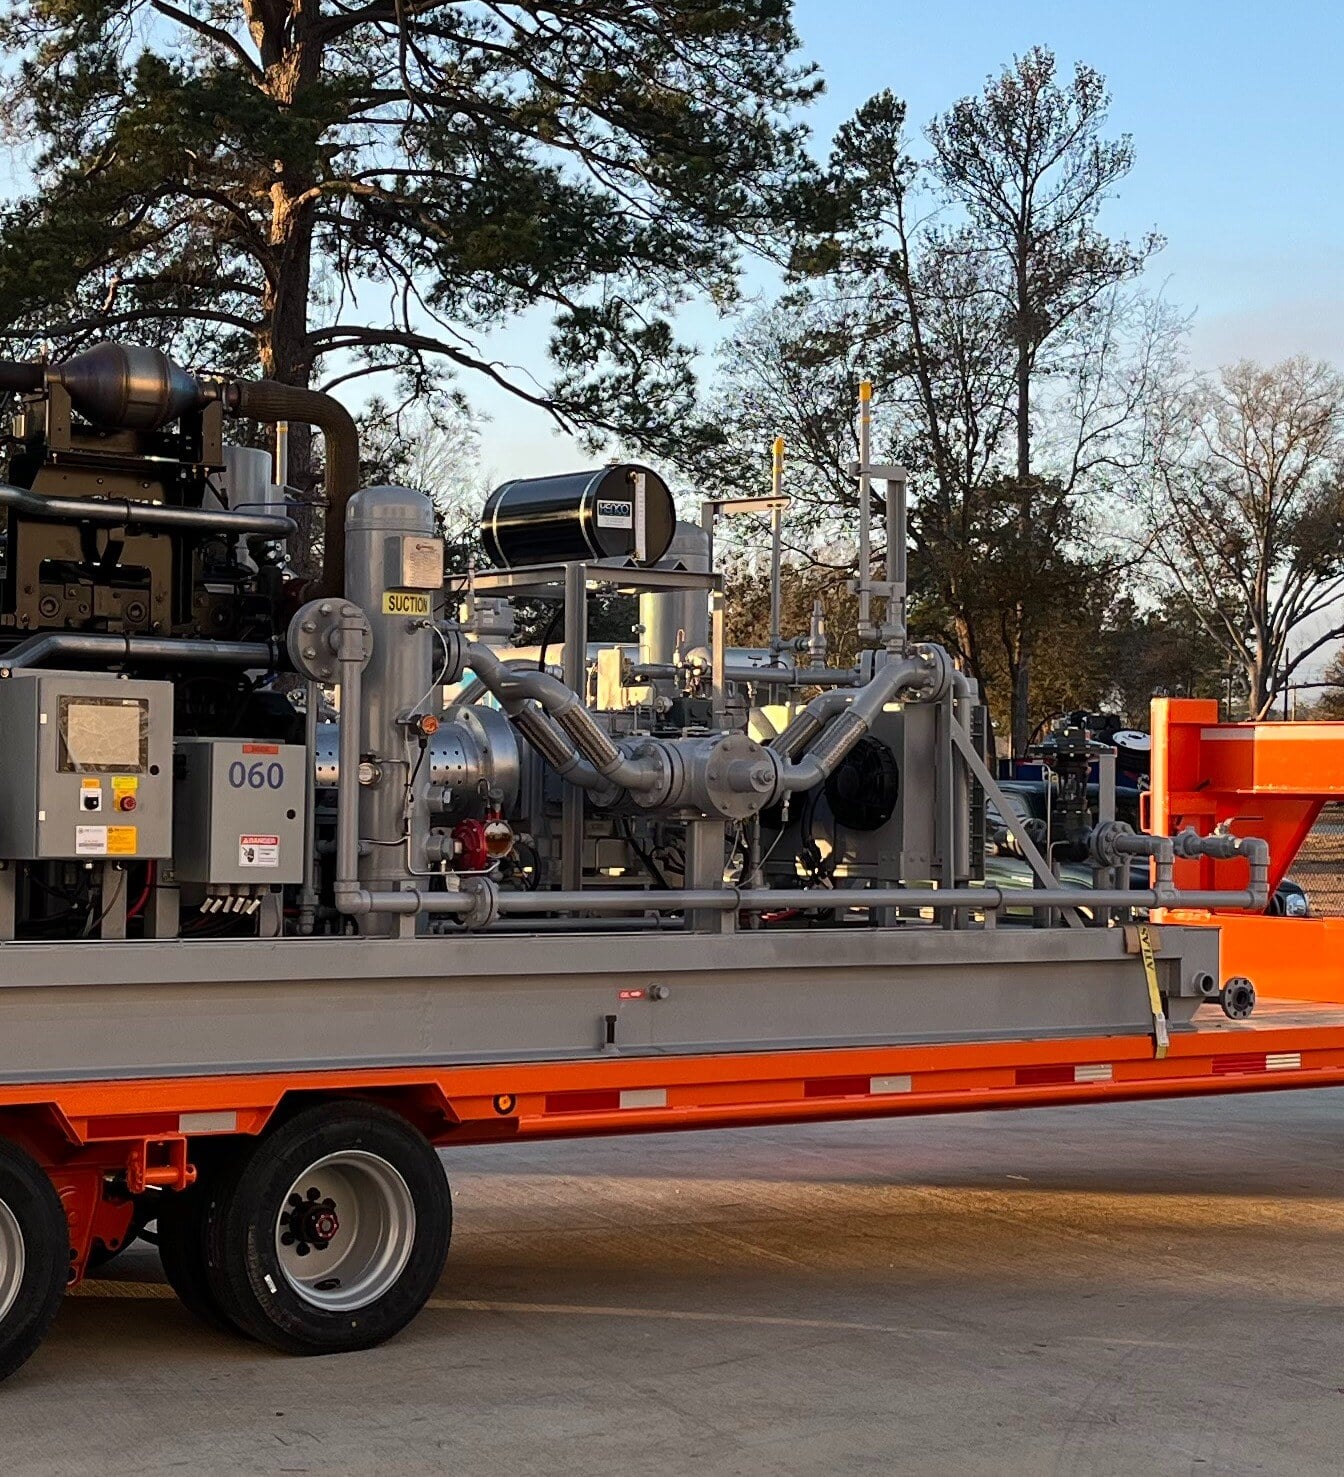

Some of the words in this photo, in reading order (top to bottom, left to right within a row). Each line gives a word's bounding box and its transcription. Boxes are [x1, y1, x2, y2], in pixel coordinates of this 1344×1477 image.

[388, 595, 428, 613] SUCTION
[228, 761, 285, 790] 060
[248, 836, 277, 845] DANGER
[1141, 927, 1154, 971] ATLAS
